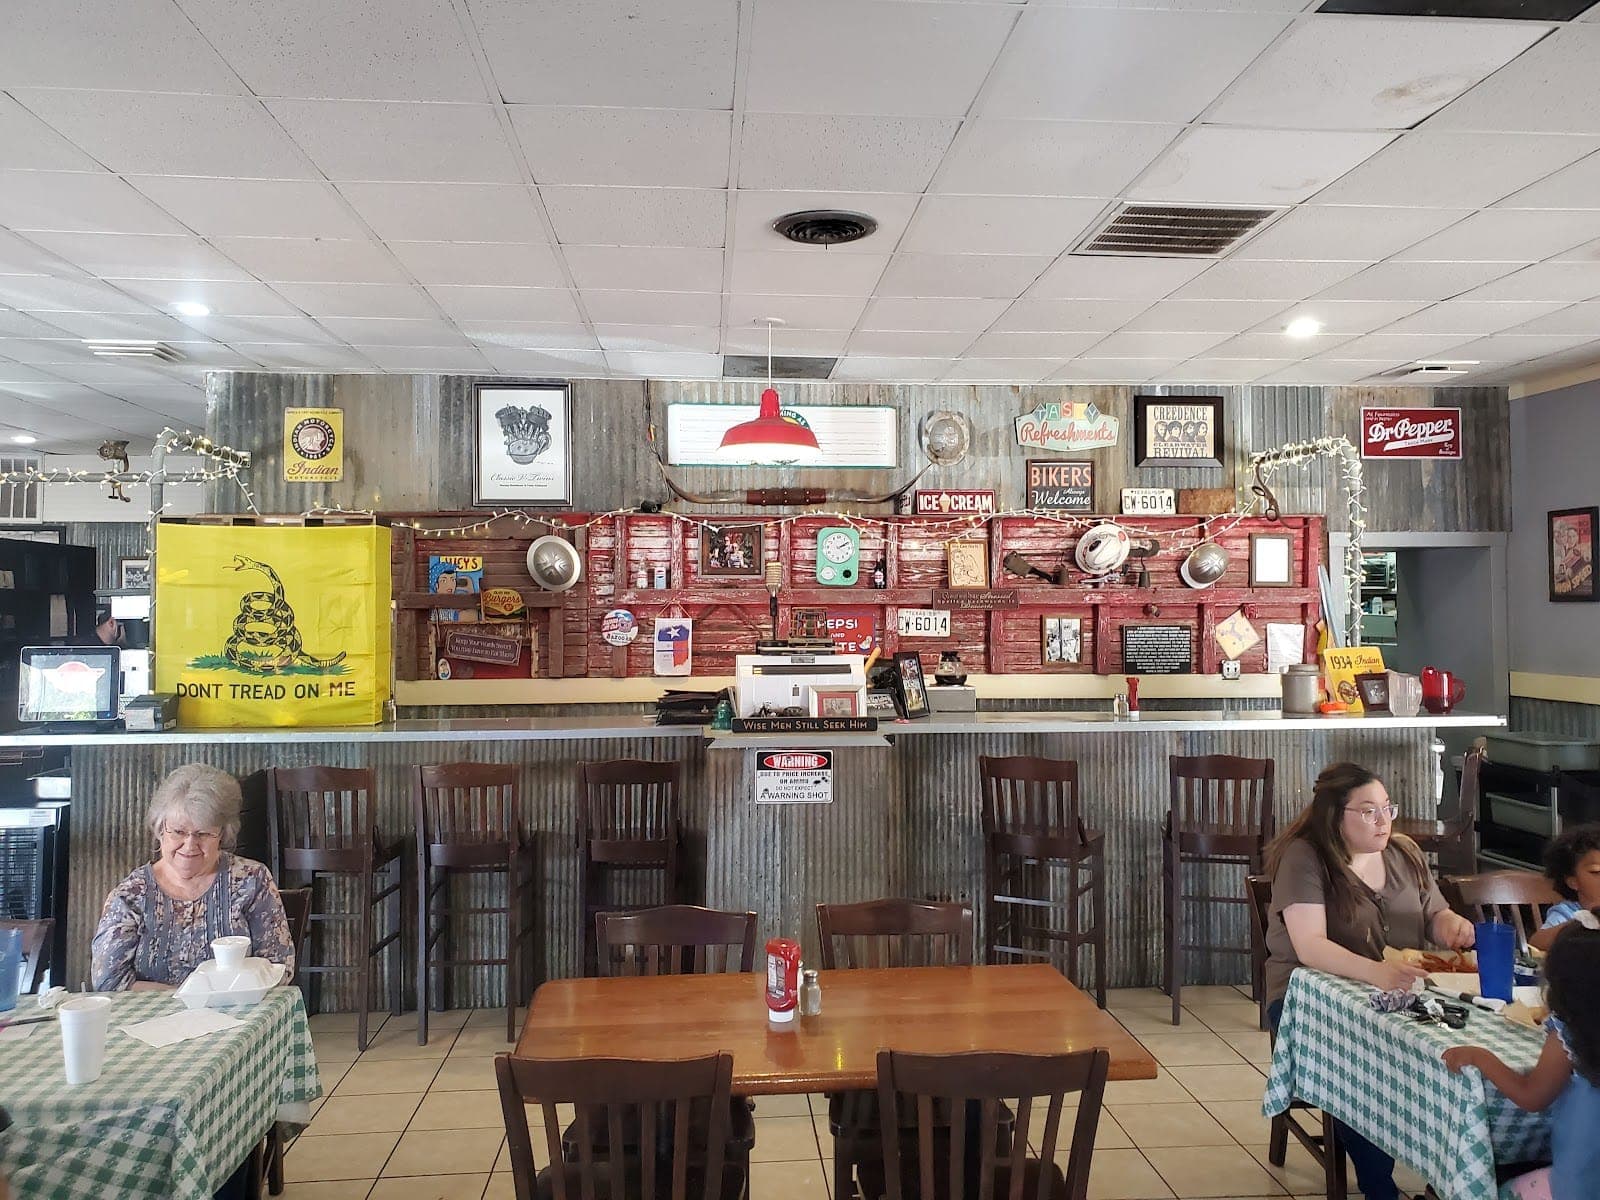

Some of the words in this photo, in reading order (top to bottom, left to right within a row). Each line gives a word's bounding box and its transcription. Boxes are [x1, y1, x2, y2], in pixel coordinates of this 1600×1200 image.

[1037, 402, 1099, 420] TASY
[1153, 407, 1208, 420] CREEDENCE
[1021, 421, 1115, 446] Refreshments
[1367, 421, 1394, 443] Dr
[1394, 418, 1453, 440] Pepper
[1153, 448, 1208, 457] REVIVAL
[287, 461, 339, 475] Indian
[1032, 467, 1091, 487] BIKERS
[919, 495, 940, 510] ICE
[951, 495, 993, 511] CREAM
[1032, 490, 1091, 505] Welcome
[1330, 655, 1353, 669] 1934
[1355, 654, 1380, 666] Indian
[229, 683, 287, 700] TREAD
[294, 683, 320, 698] ON
[329, 681, 356, 697] ME
[773, 755, 818, 768] WARNING
[806, 791, 829, 799] SHOT
